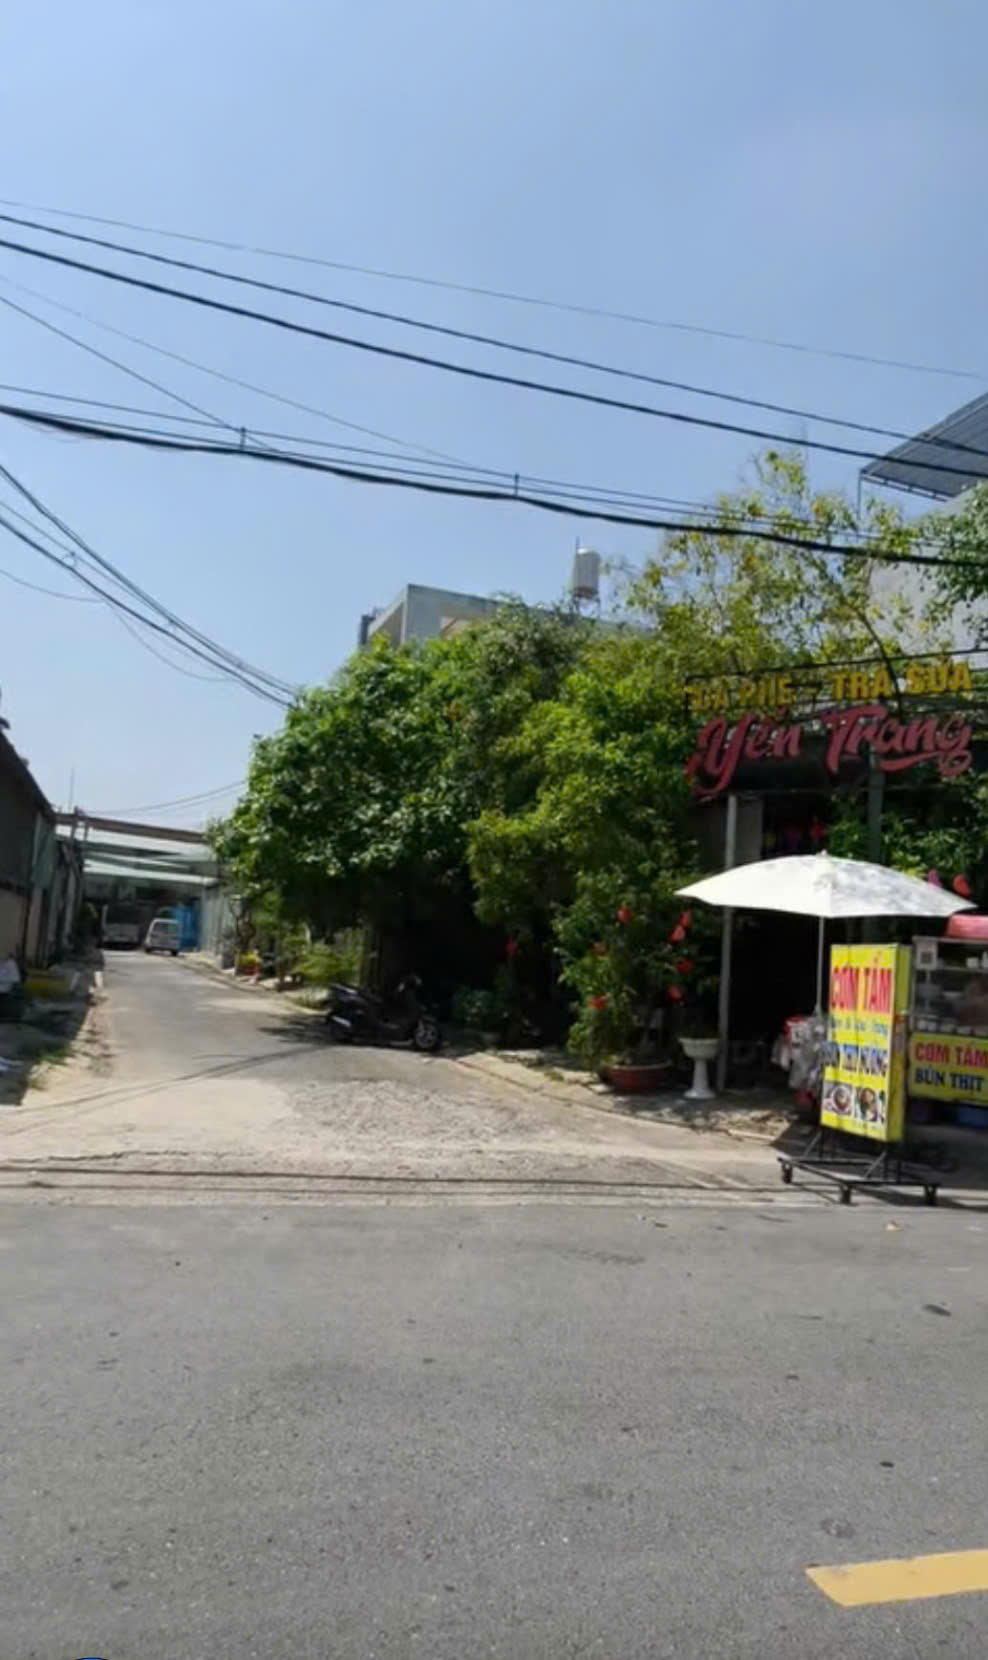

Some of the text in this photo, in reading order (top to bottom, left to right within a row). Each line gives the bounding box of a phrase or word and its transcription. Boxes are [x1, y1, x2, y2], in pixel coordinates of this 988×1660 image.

[819, 704, 973, 778] Trang
[915, 1064, 984, 1097] BÚN THỊT
